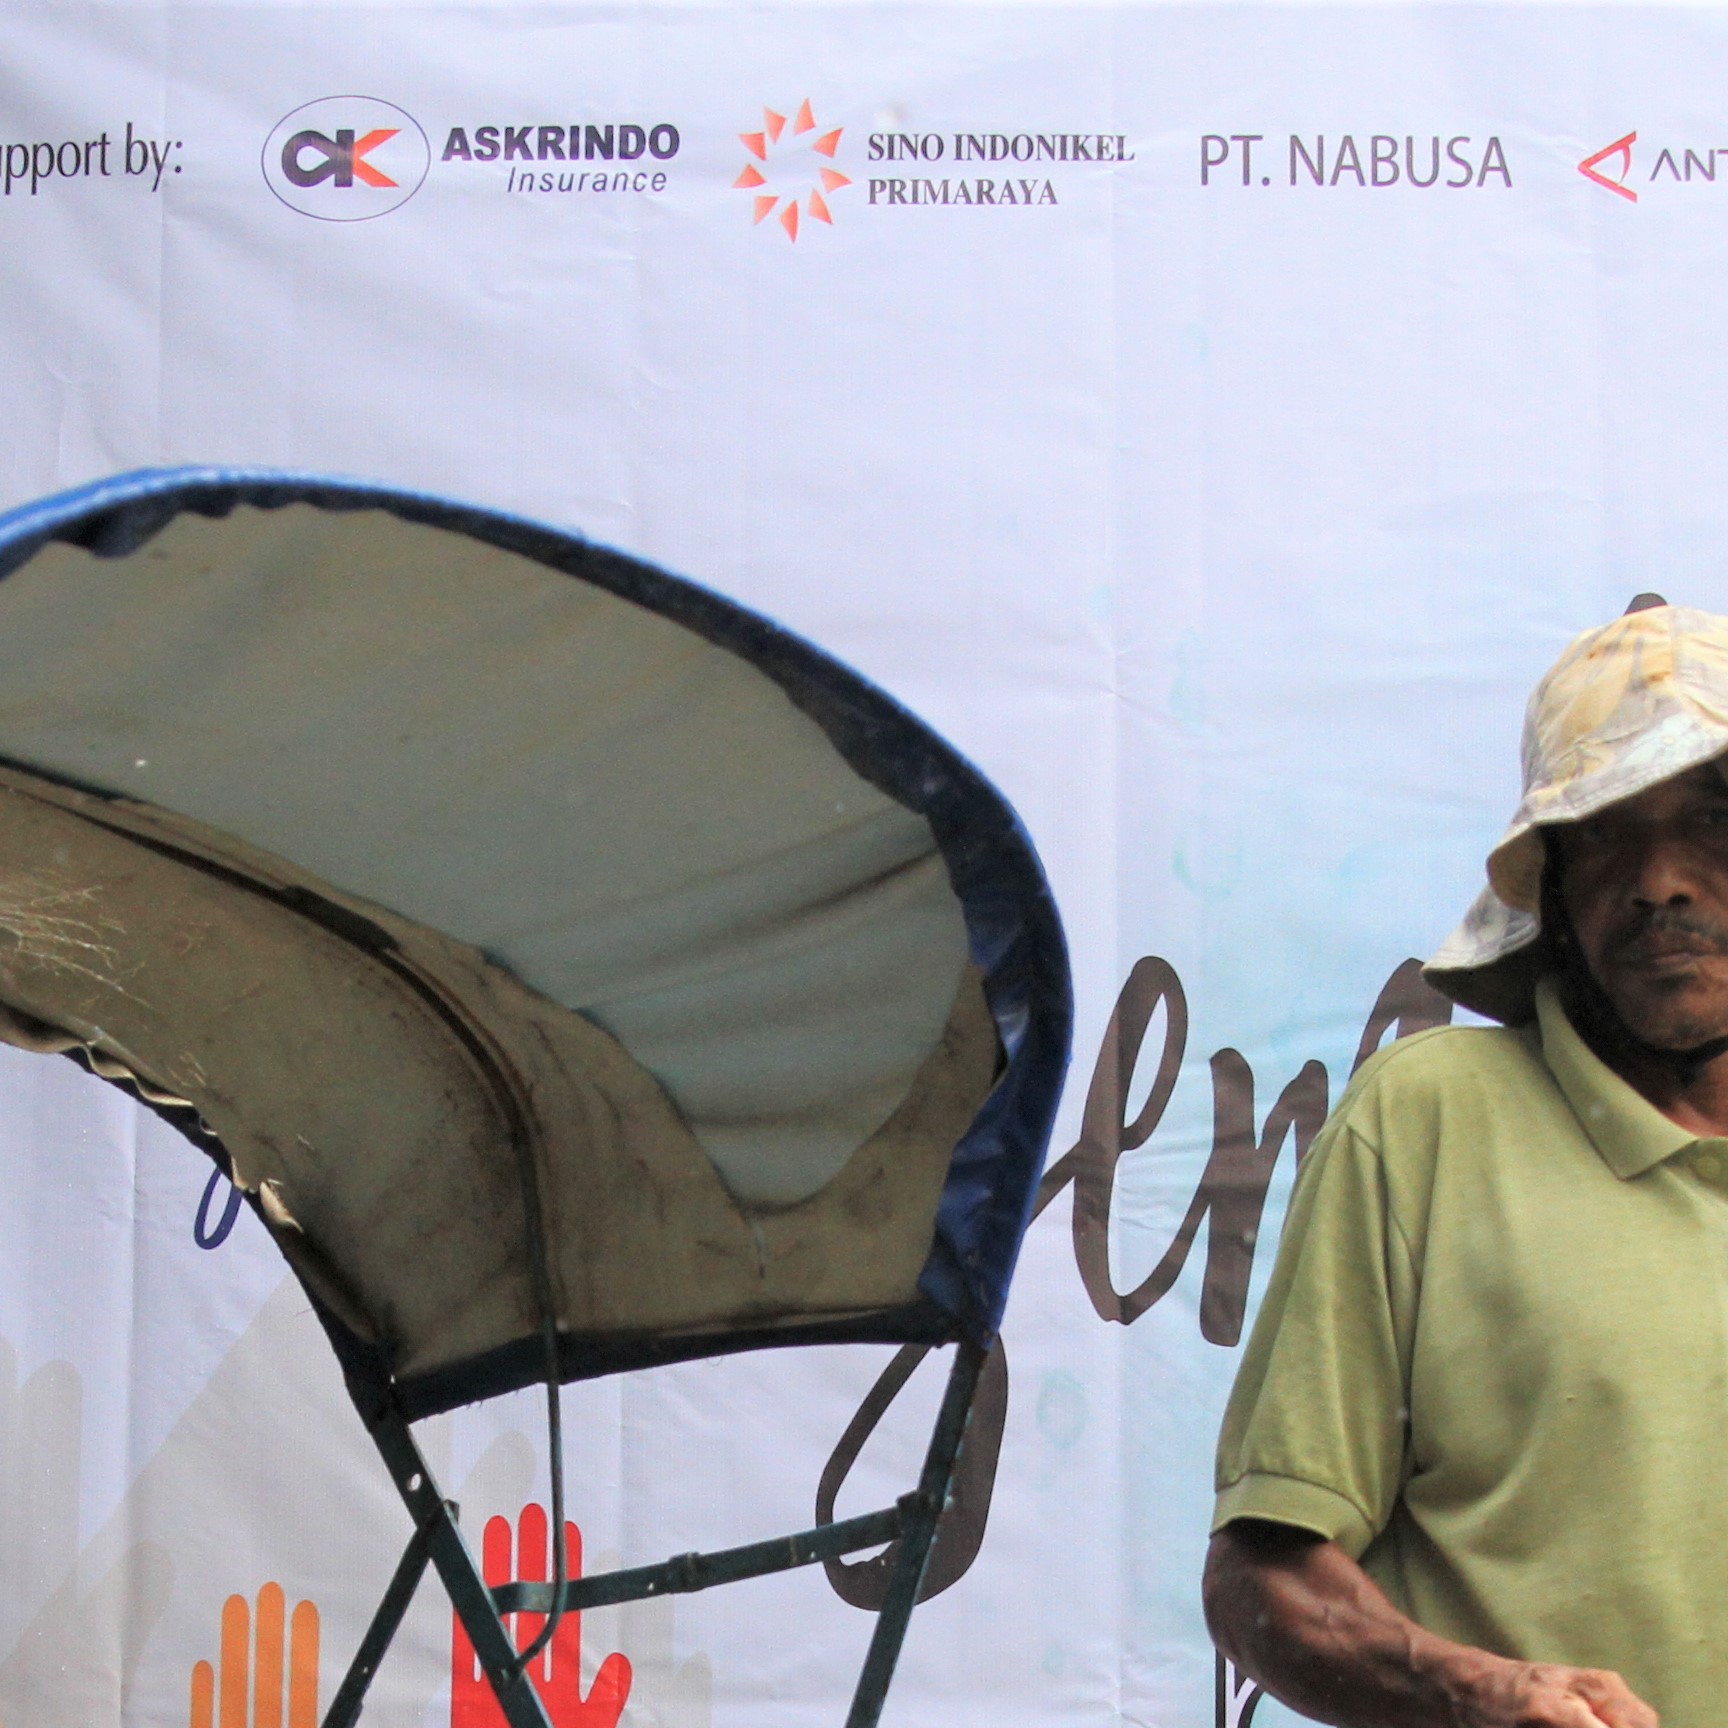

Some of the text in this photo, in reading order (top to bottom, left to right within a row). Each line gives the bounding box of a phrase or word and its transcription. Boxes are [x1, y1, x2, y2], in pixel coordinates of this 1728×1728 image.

[124, 122, 184, 194] by:
[442, 123, 681, 163] ASKRINDO
[868, 133, 1136, 163] SINO INDONIKEL
[1200, 134, 1514, 190] PT. NABUSA
[507, 167, 668, 194] Insurance
[868, 179, 1059, 206] PRIMARAYA
